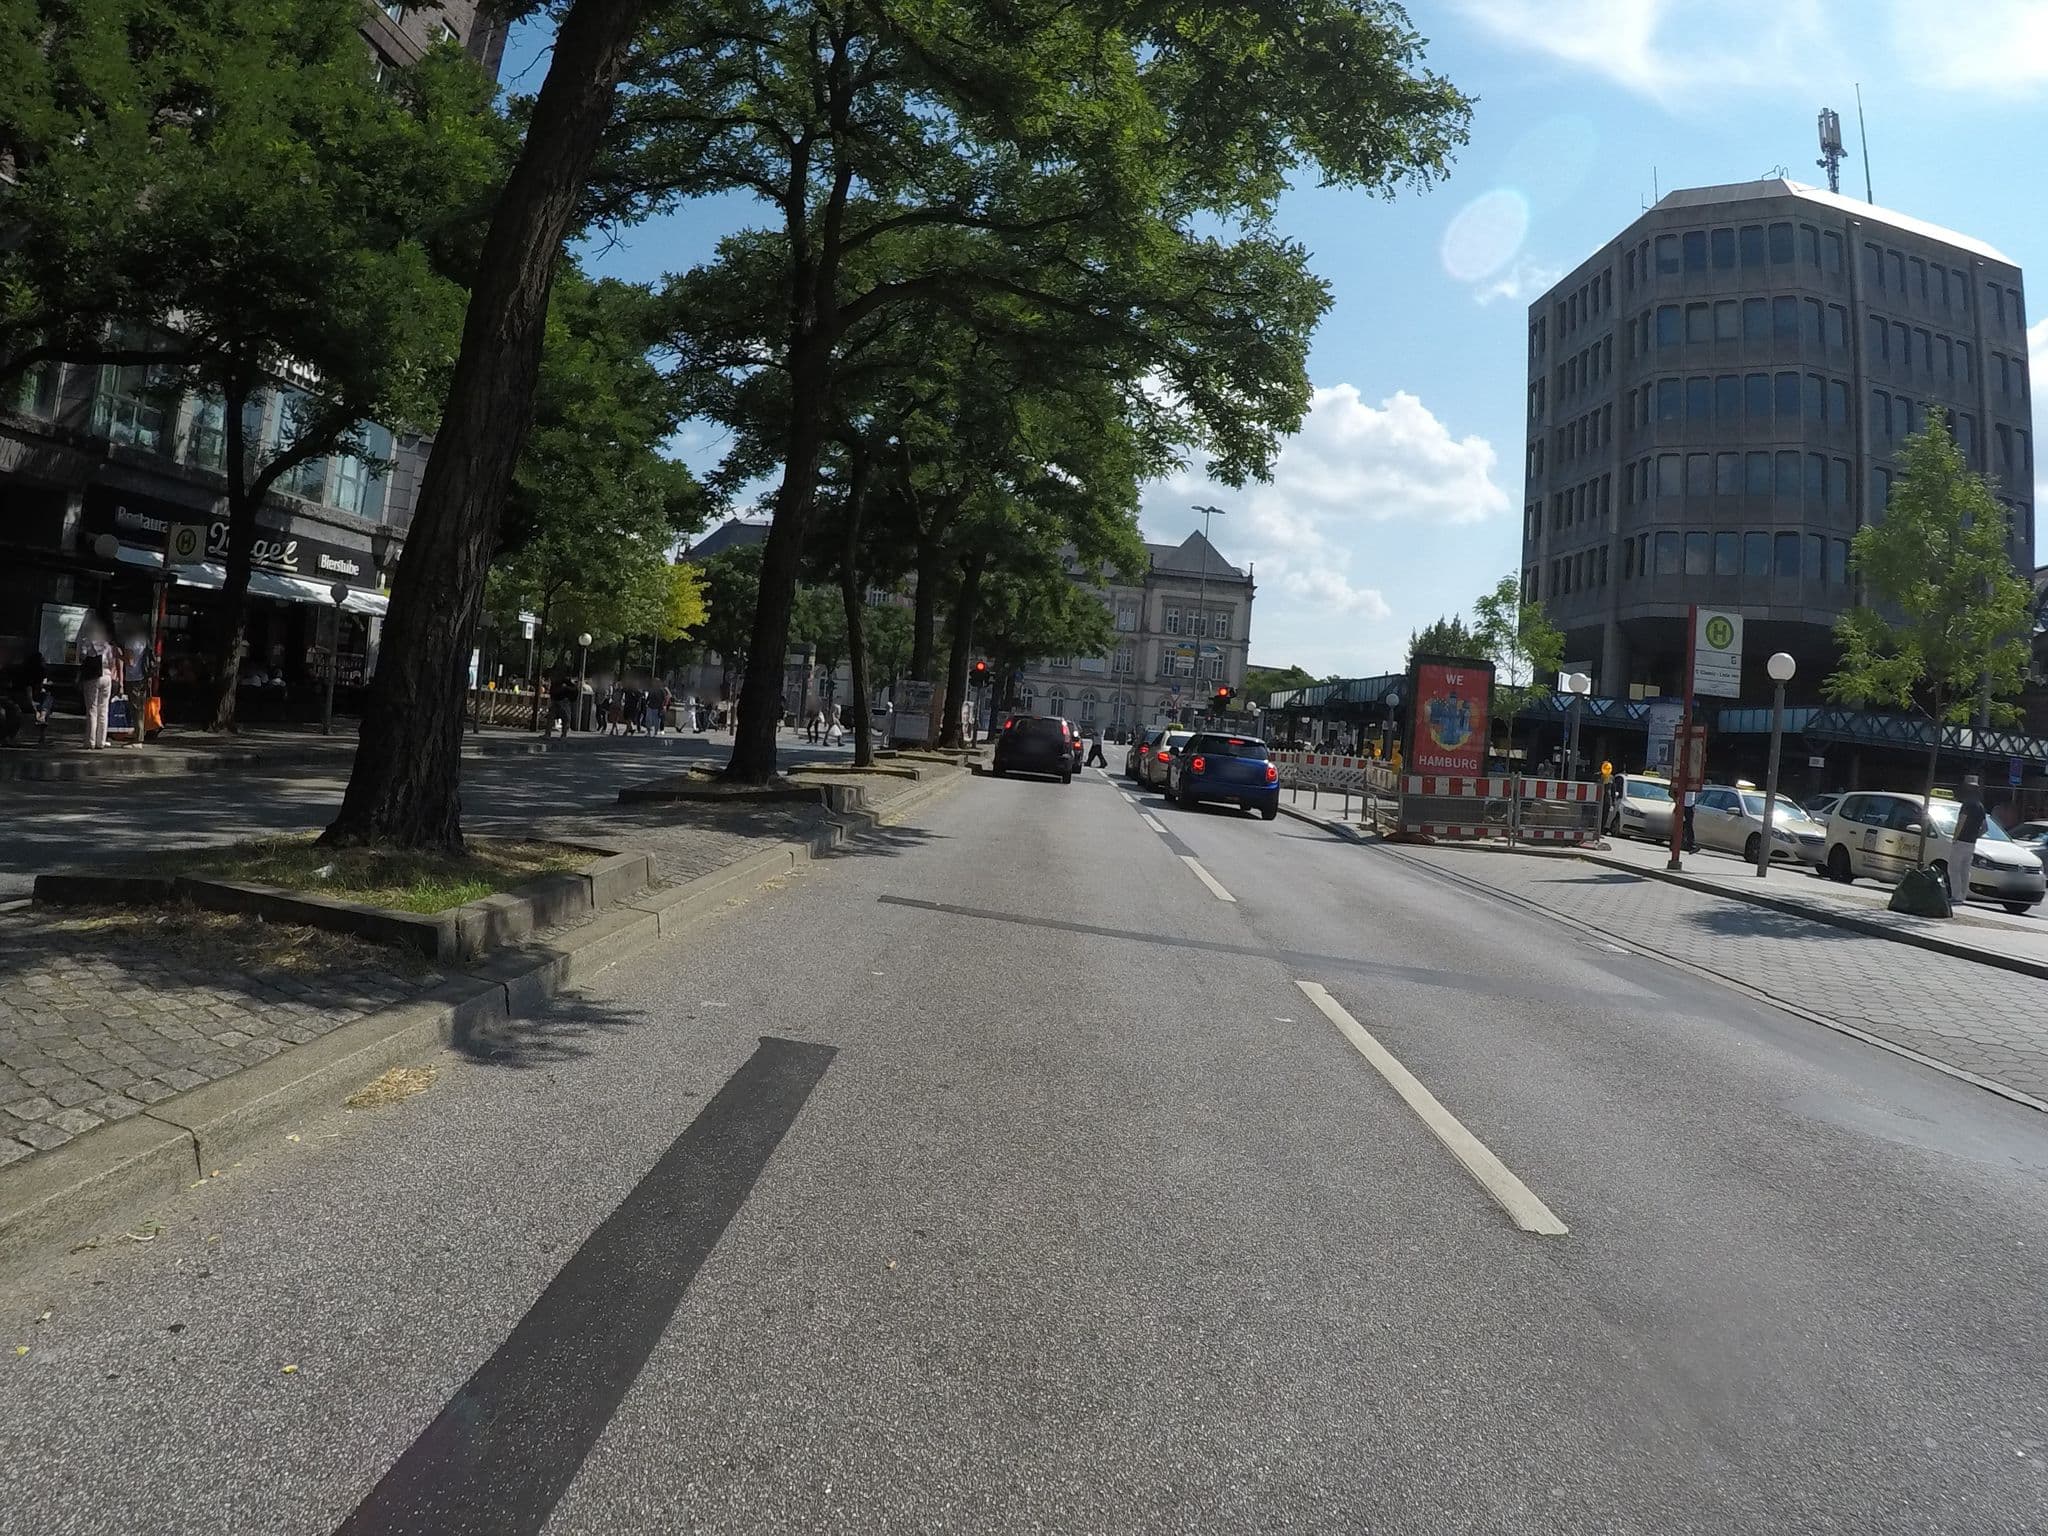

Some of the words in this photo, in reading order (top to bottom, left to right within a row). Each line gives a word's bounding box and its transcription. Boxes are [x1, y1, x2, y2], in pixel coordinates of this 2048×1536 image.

[320, 553, 360, 576] Bierstube
[1713, 623, 1728, 642] H
[1446, 673, 1464, 686] WE
[1419, 754, 1478, 770] HAMBURG
